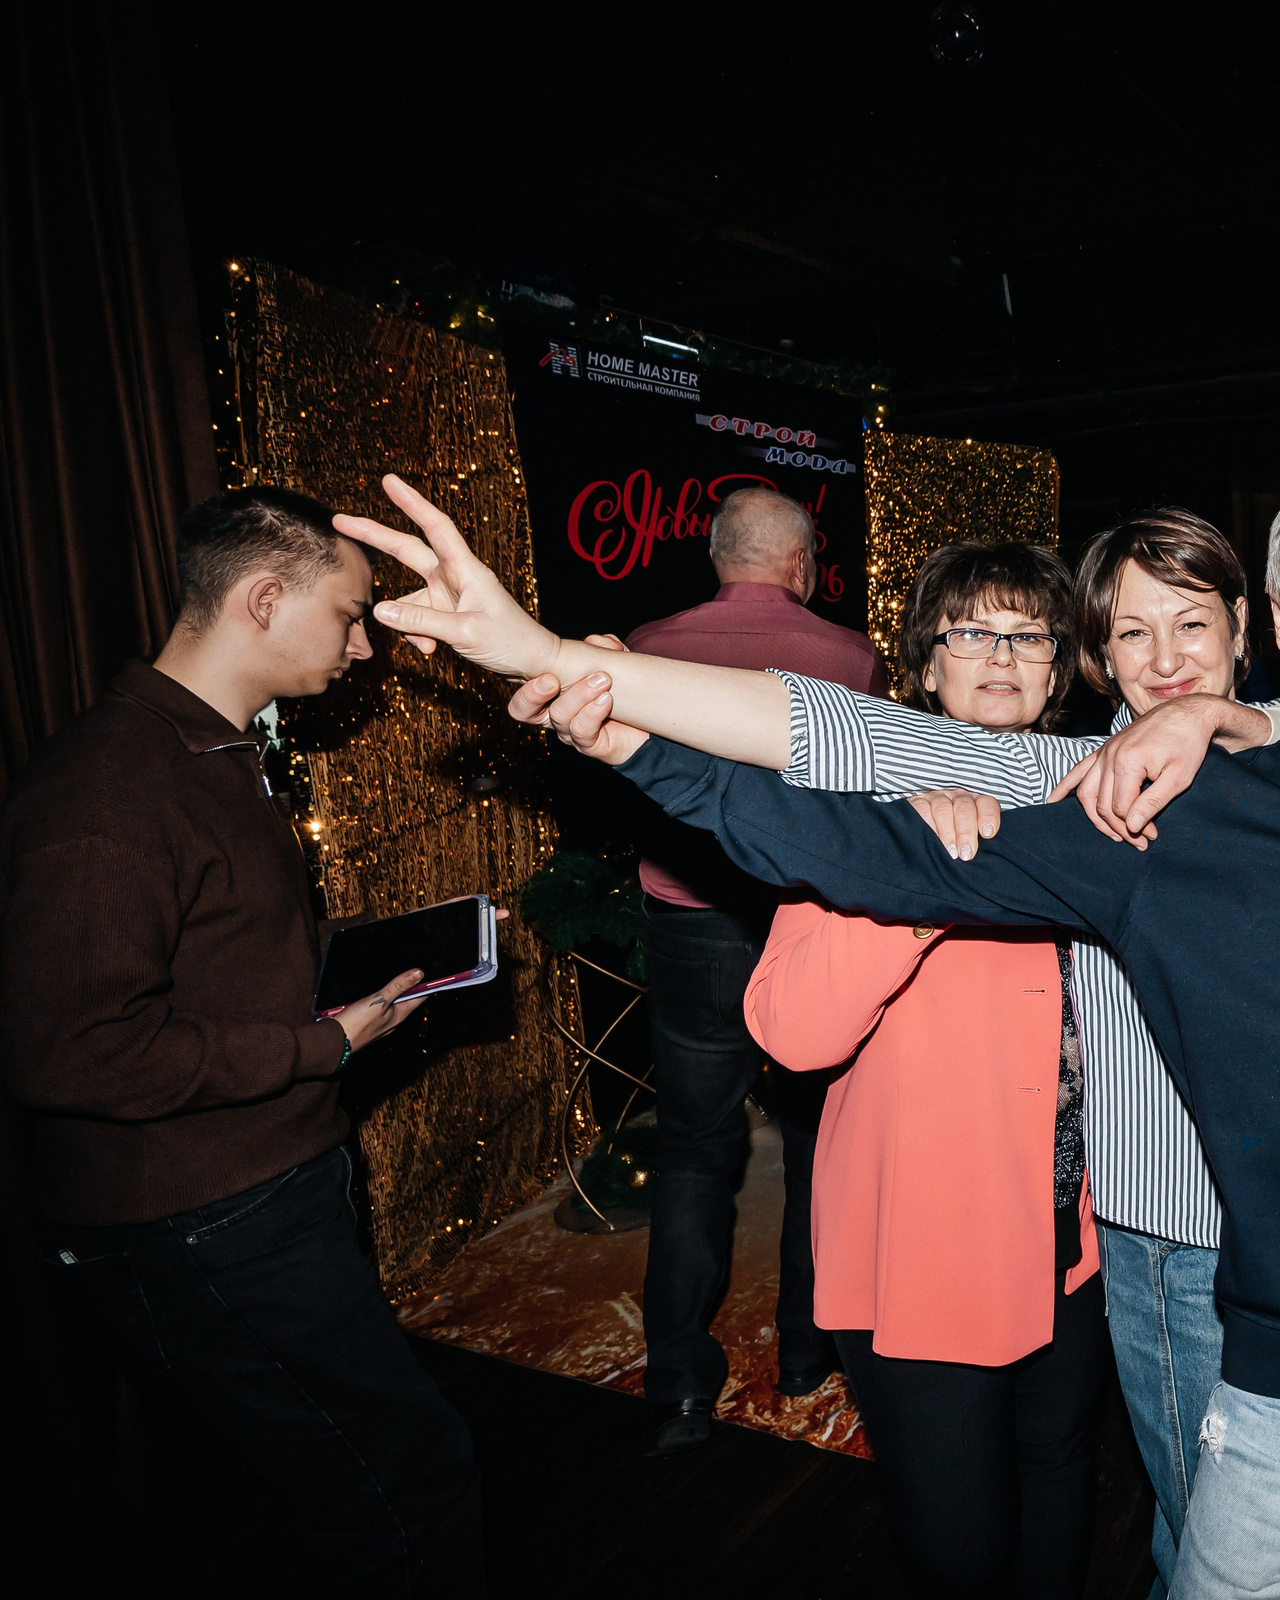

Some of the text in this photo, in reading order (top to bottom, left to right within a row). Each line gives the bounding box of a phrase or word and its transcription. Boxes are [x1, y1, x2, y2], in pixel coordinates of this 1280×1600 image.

[587, 351, 699, 387] HOME MASTER
[587, 372, 700, 402] СТРОИТЕЛЬНАЯ КОМПАНИЯ
[709, 414, 817, 448] СТРОЙ
[593, 468, 712, 580] Новы
